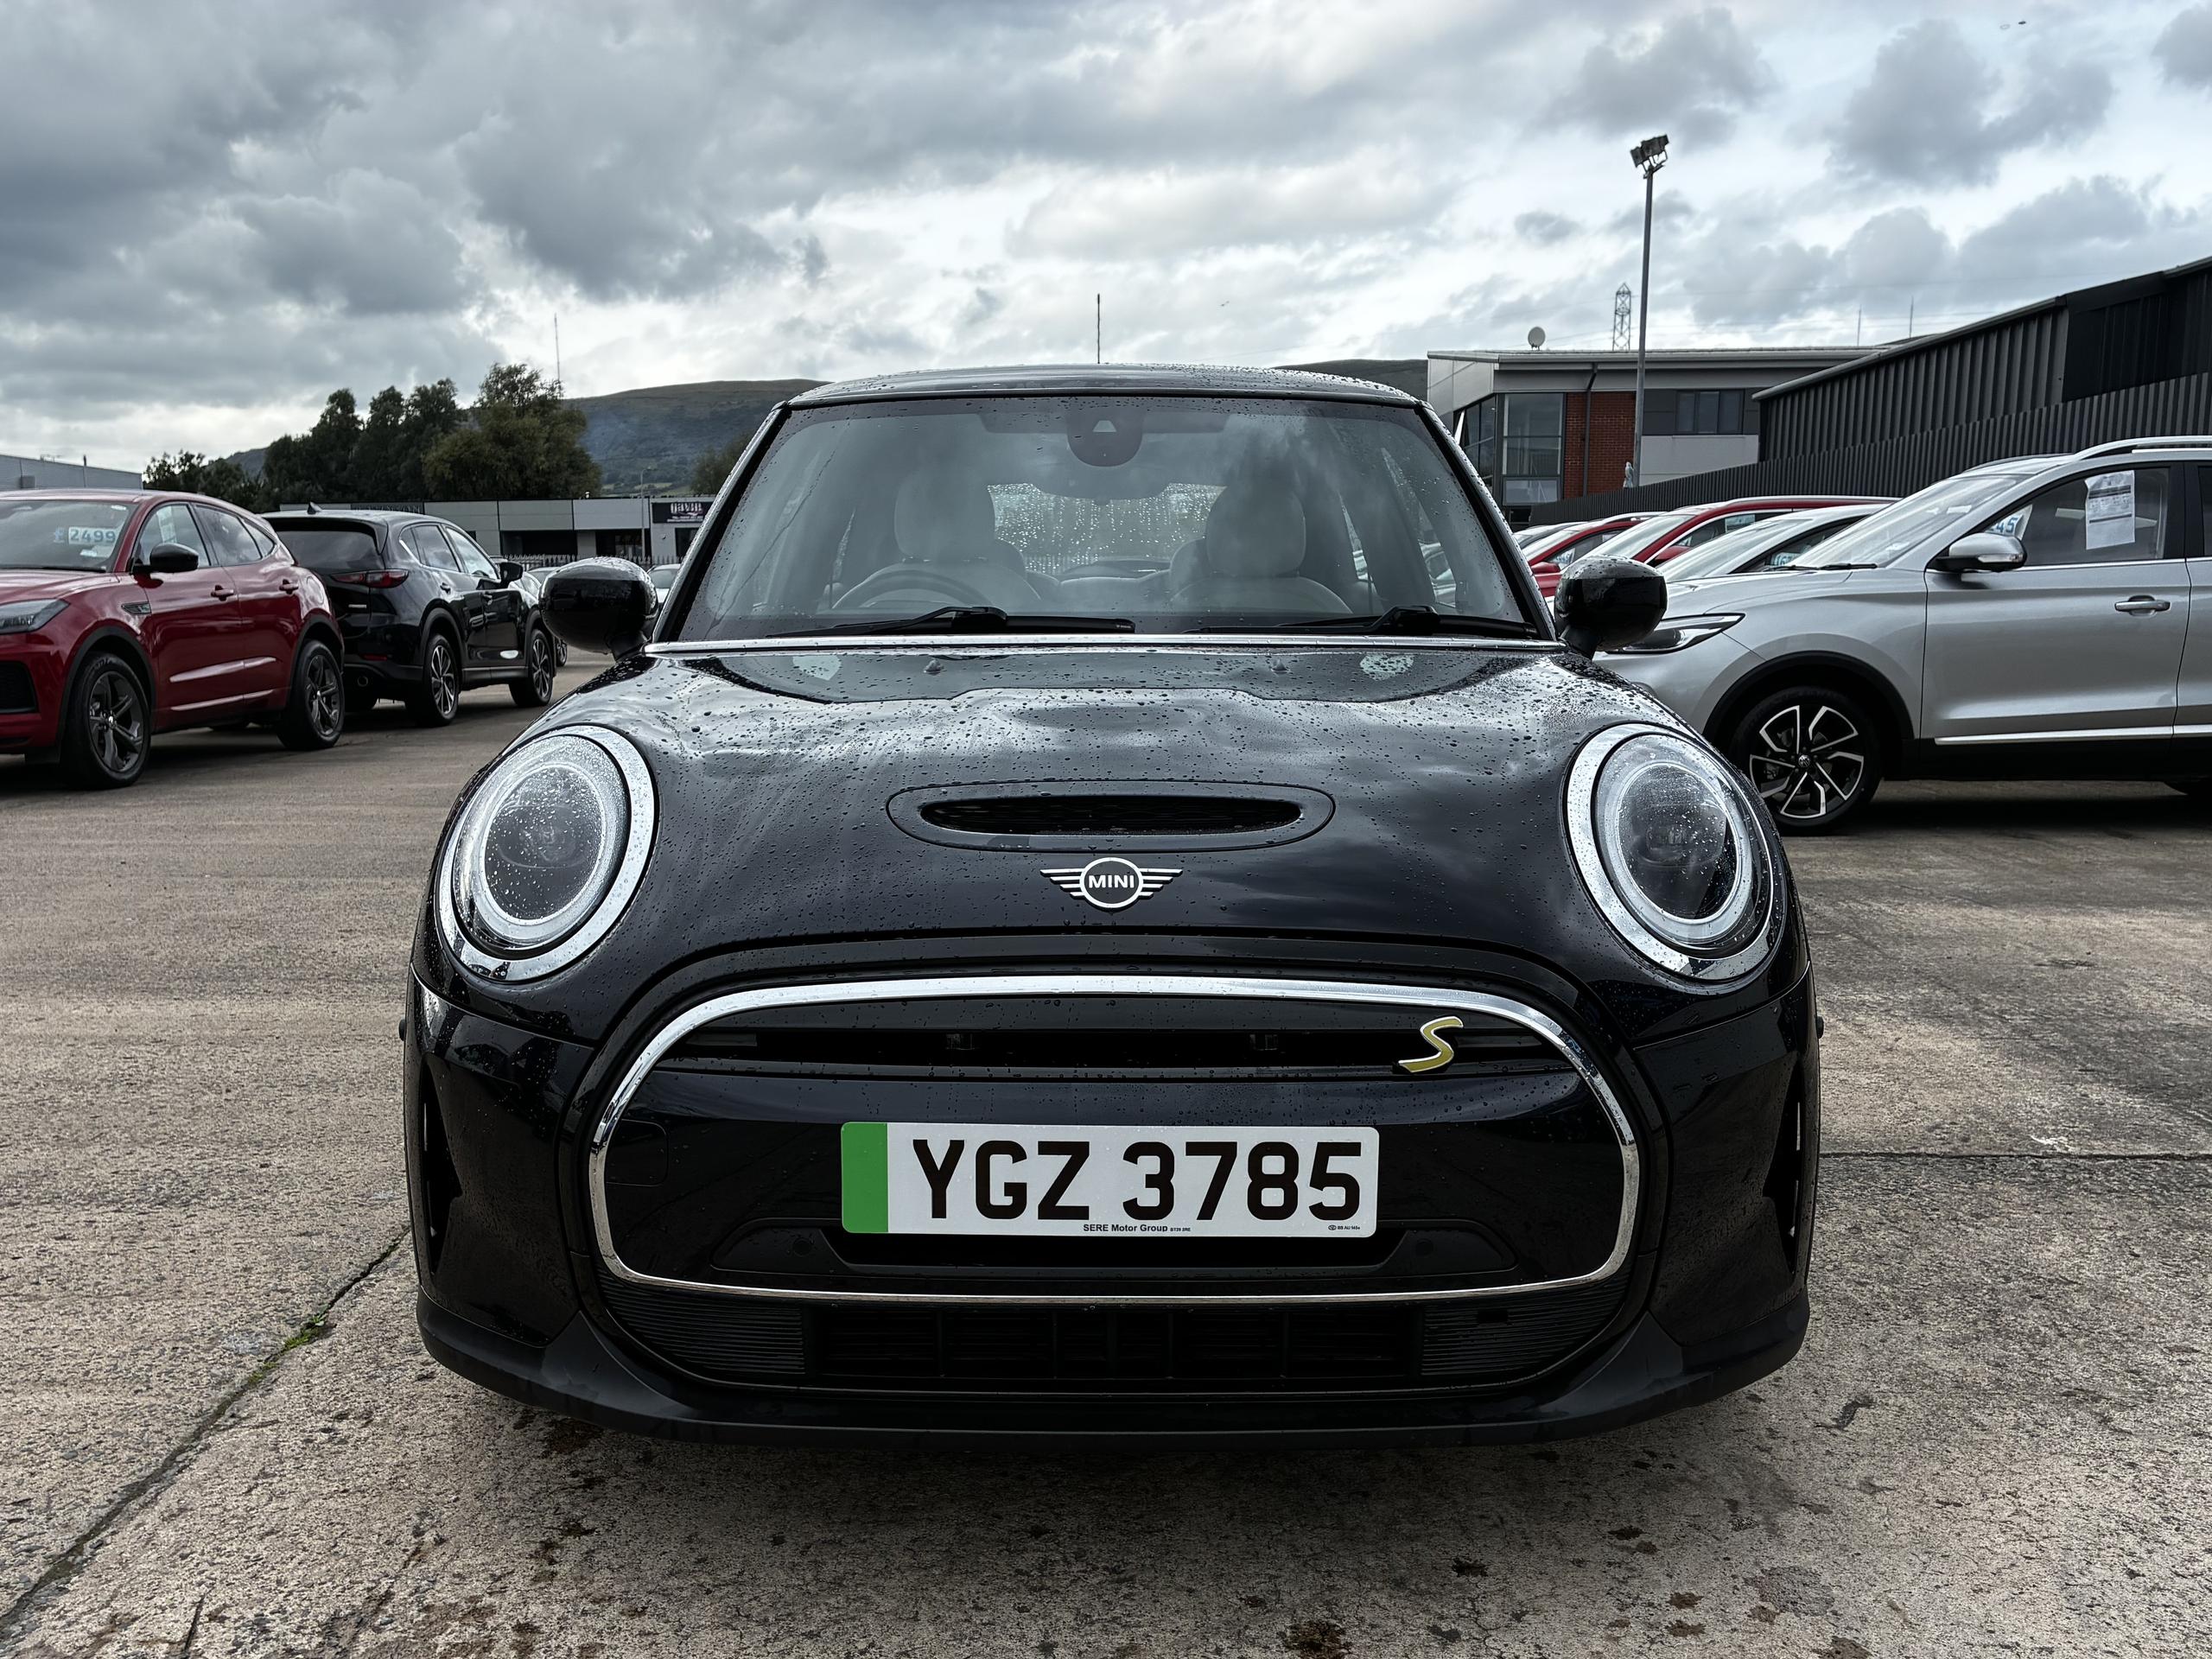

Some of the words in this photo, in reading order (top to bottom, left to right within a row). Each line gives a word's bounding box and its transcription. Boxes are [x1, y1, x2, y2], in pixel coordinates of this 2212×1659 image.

[1088, 874, 1135, 888] MINI
[1398, 1015, 1464, 1072] S
[912, 1139, 1090, 1220] YGZ
[1122, 1141, 1363, 1221] 3785
[1083, 1224, 1109, 1232] SERE
[1111, 1224, 1138, 1232] Motor
[1140, 1224, 1168, 1233] Group
